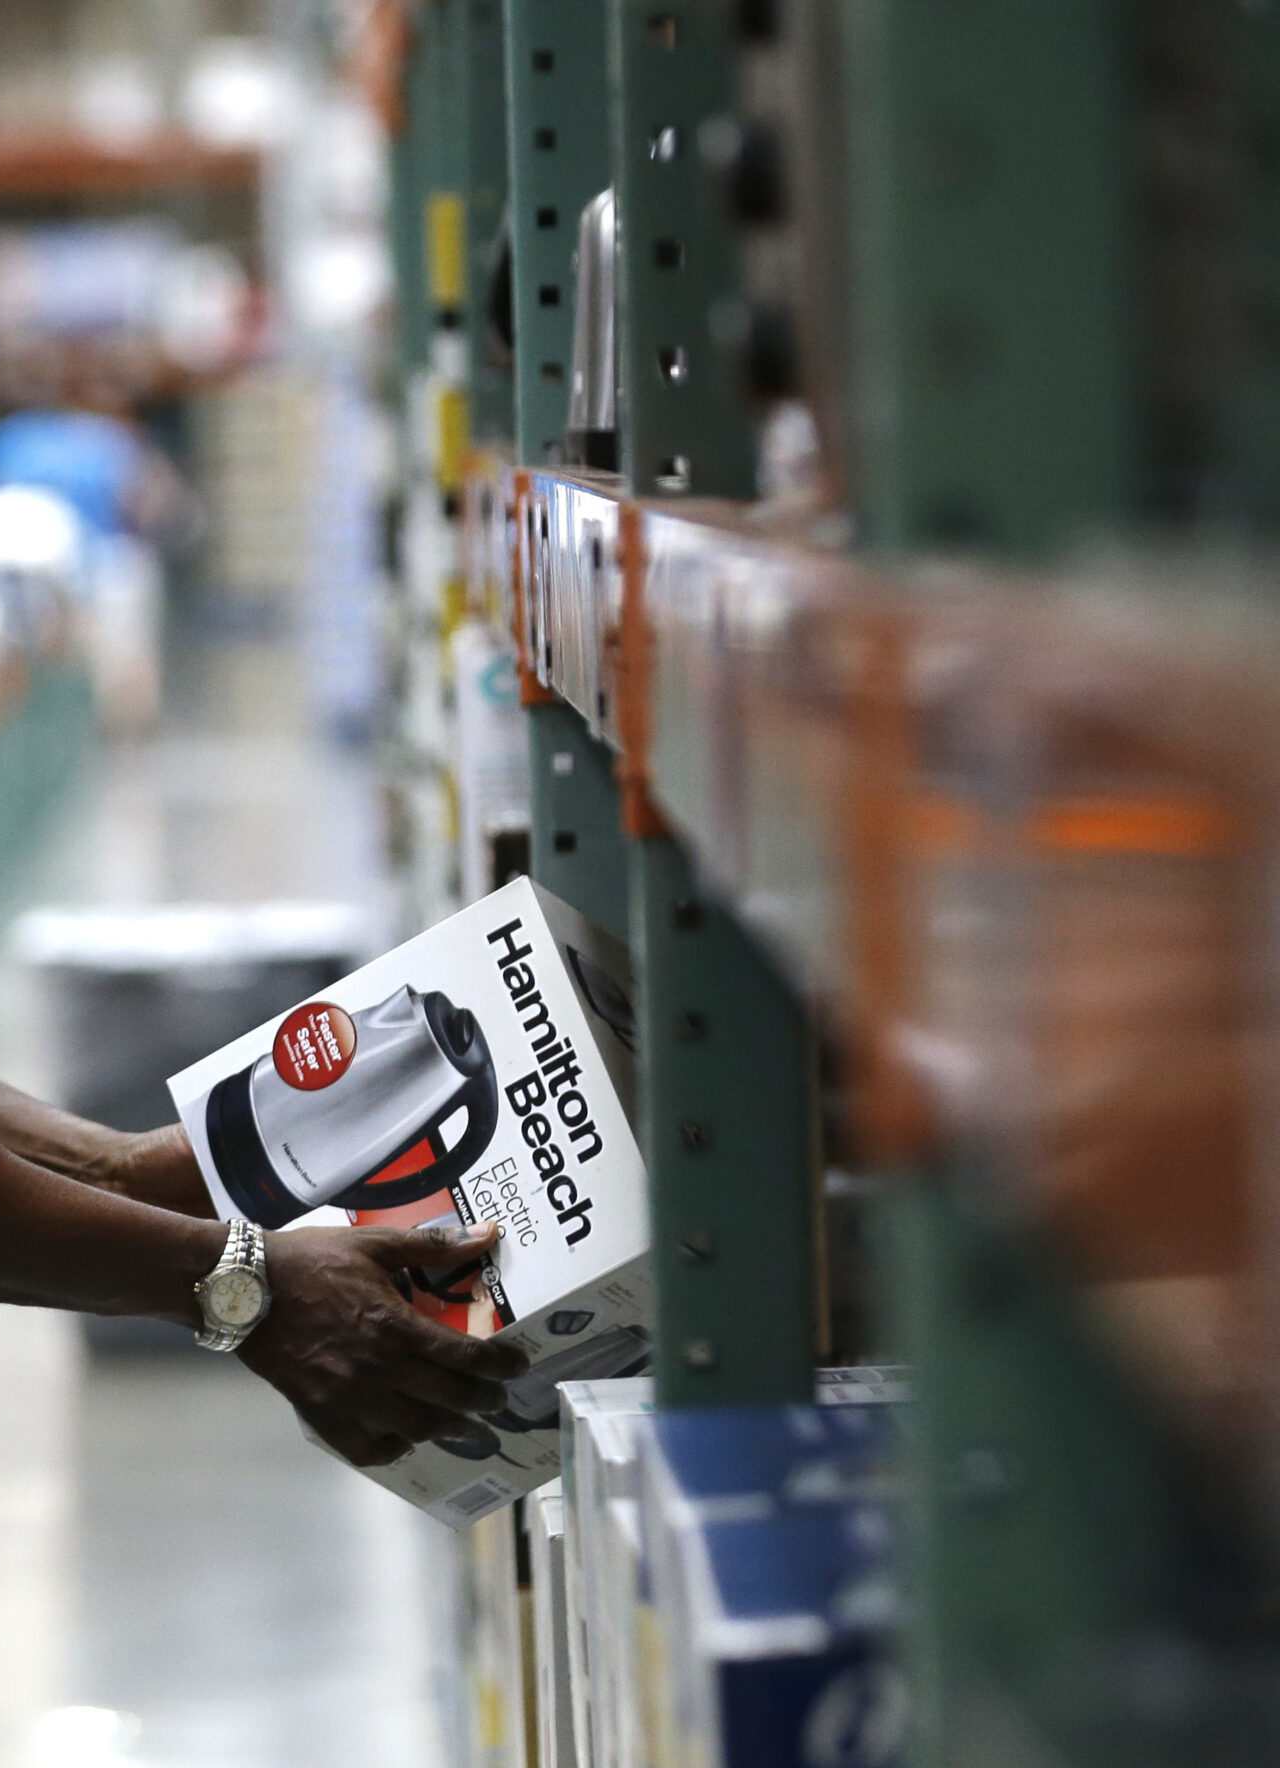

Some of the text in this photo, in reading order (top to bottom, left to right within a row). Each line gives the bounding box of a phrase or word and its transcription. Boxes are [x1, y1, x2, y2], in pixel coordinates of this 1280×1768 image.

[297, 1027, 320, 1070] Safer
[316, 1011, 342, 1060] Faster
[486, 917, 603, 1164] Hamilton
[503, 1069, 594, 1247] Beach
[451, 1186, 473, 1226] STAINLE
[491, 1156, 539, 1247] Electric
[491, 1285, 505, 1306] CUP
